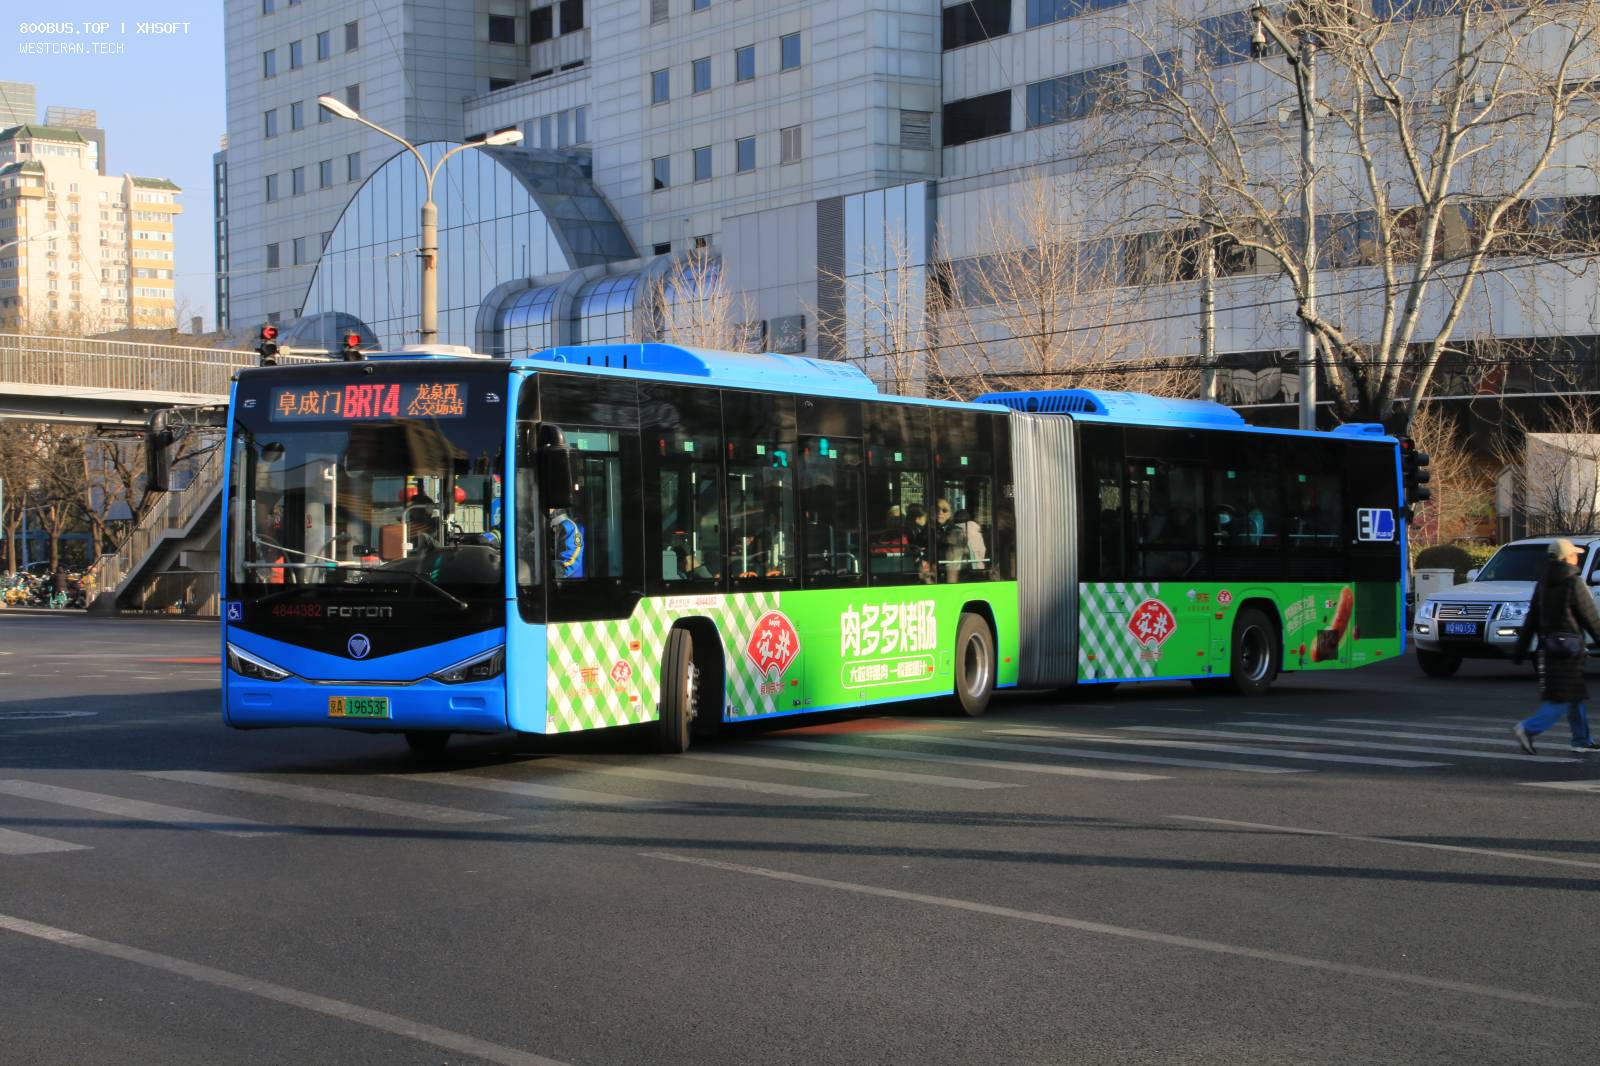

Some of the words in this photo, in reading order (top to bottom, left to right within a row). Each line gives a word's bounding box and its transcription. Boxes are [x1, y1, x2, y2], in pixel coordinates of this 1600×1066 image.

[415, 383, 460, 400] 龙泉西
[276, 391, 341, 416] 阜成门
[342, 384, 400, 418] BRT4
[407, 399, 465, 416] 公交场站
